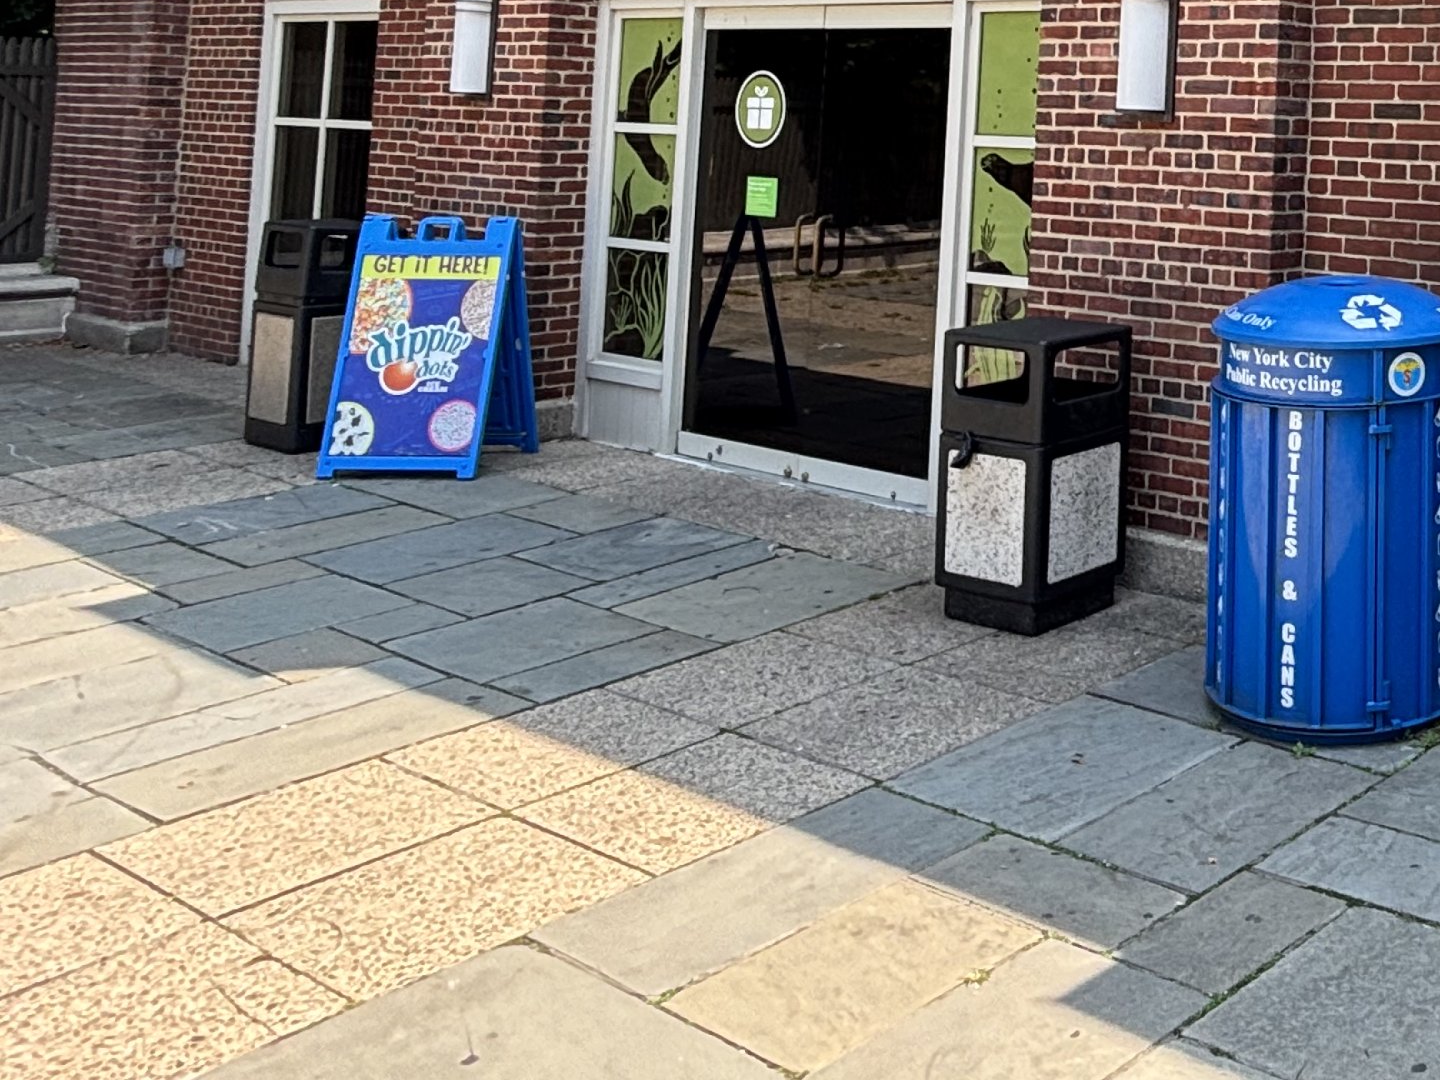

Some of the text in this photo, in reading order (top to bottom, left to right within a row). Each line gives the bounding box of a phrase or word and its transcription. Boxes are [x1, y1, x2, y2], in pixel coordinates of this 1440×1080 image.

[374, 255, 408, 273] GET
[439, 256, 489, 274] HERE!
[1242, 314, 1277, 331] Only
[416, 360, 454, 378] dots
[1229, 342, 1333, 373] New York City
[1226, 363, 1342, 396] Public Recycling
[1280, 410, 1303, 708] BOTTLES & CANS
